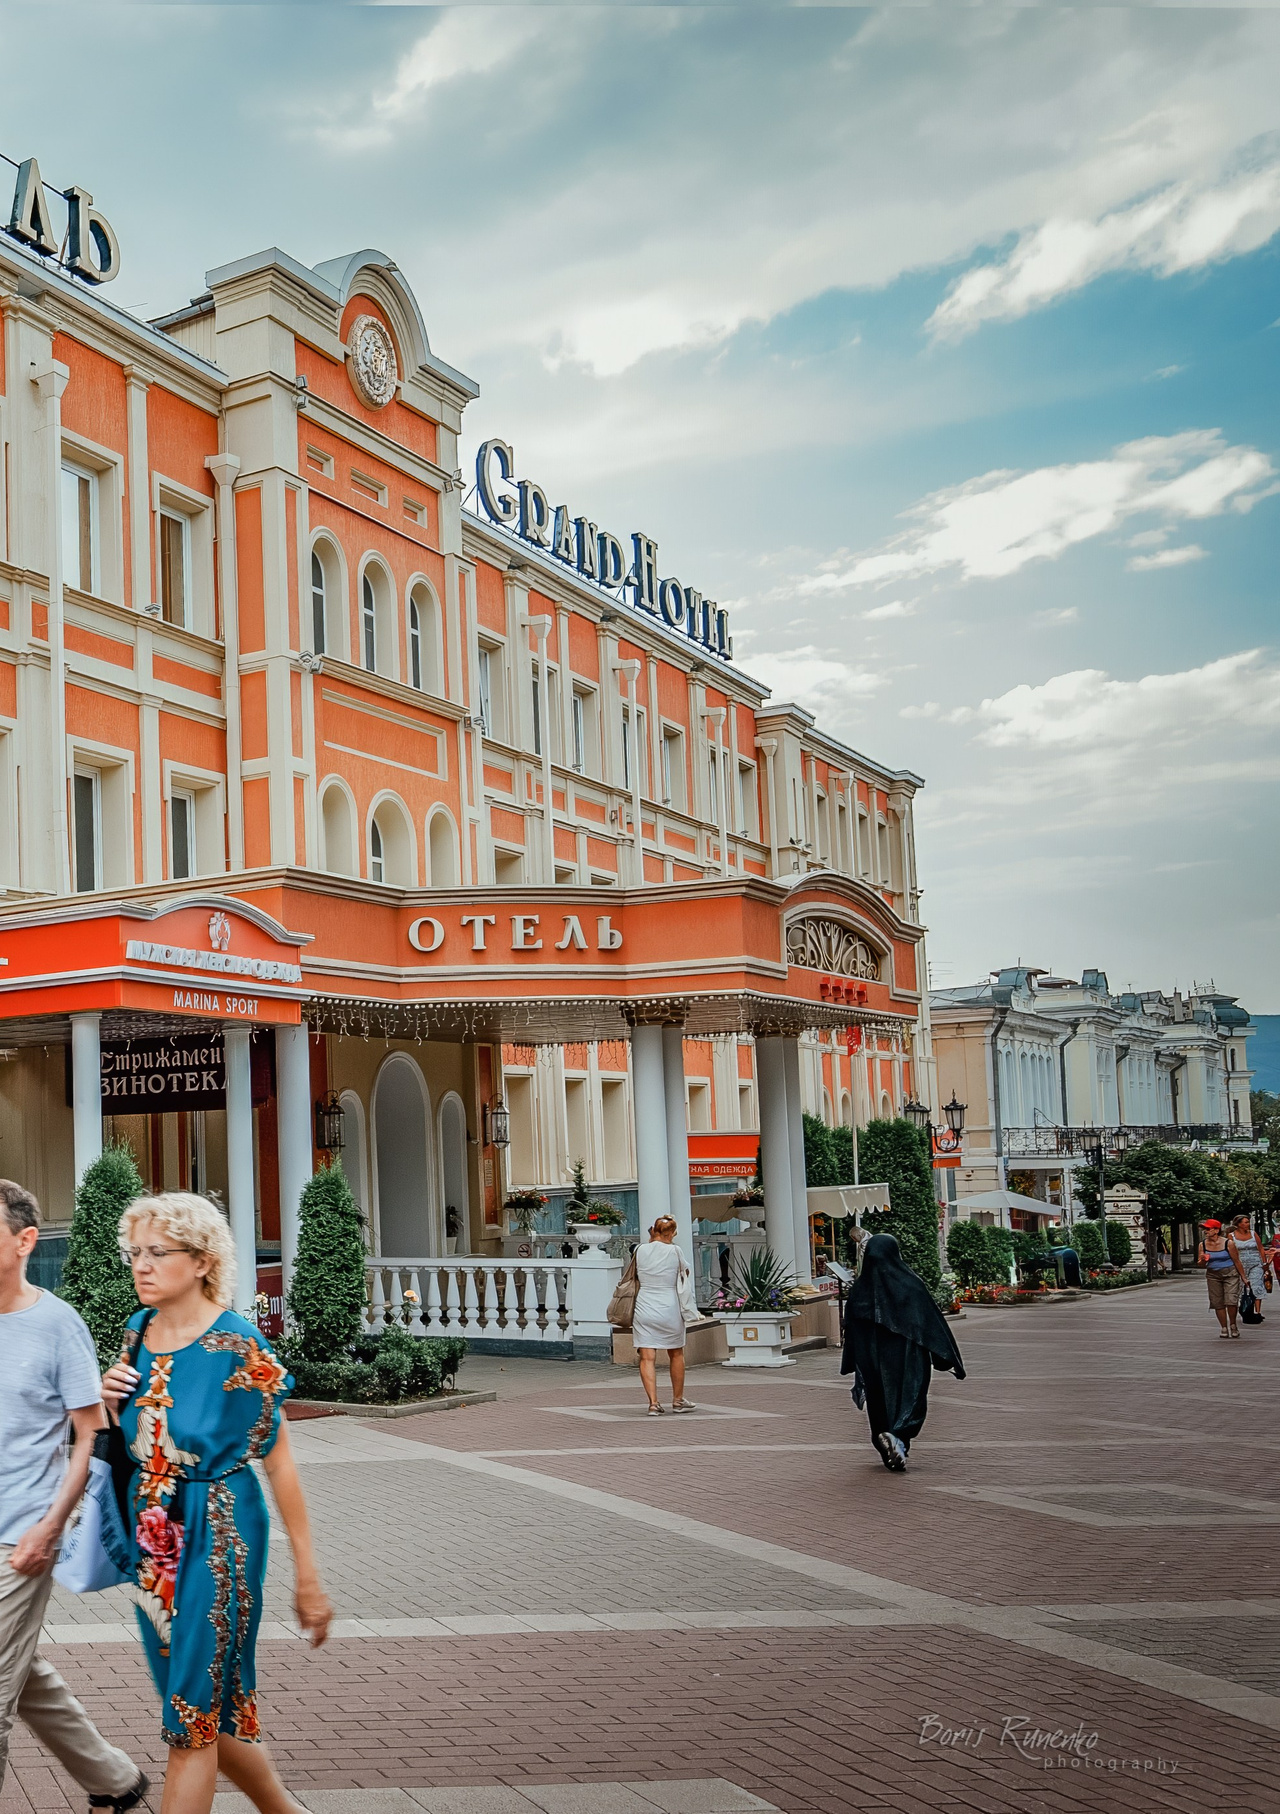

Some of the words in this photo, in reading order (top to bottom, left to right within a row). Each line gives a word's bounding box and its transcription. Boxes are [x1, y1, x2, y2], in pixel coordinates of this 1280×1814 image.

[408, 914, 623, 953] ОТЕЛЬ
[173, 990, 220, 1012] MARINA
[226, 996, 259, 1016] SPORT
[101, 1047, 226, 1074] Стрижамен
[713, 1165, 754, 1174] ОДЕЖДА
